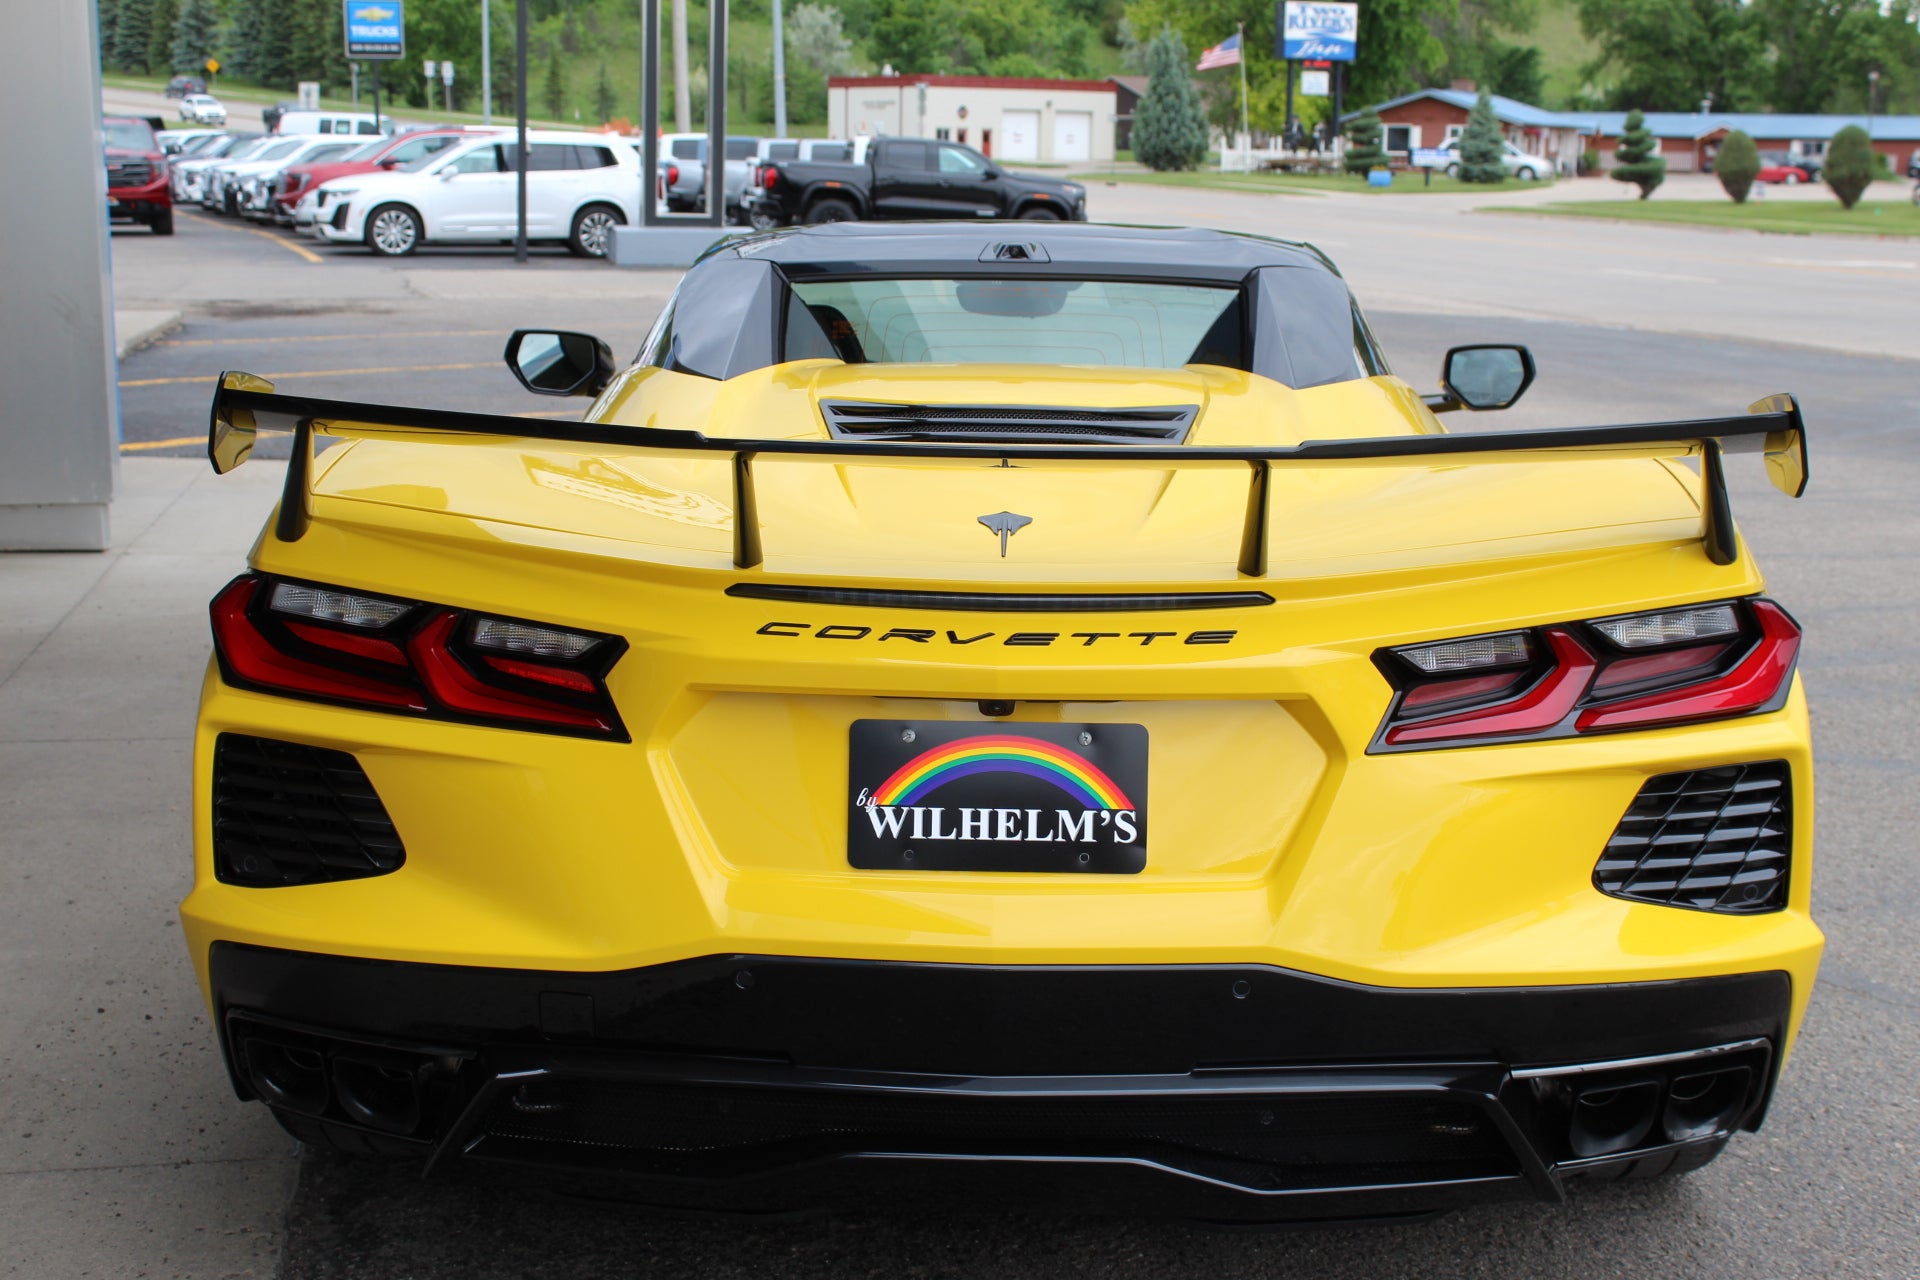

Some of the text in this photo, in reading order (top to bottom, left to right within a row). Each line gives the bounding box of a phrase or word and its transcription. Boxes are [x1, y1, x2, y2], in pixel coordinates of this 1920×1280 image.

[350, 25, 399, 38] TRUCKS
[1288, 14, 1353, 30] RIVERS
[1292, 40, 1345, 57] Inn
[756, 622, 1237, 646] CORVETTE
[856, 787, 879, 812] by
[865, 805, 1138, 844] WILHELM'S
